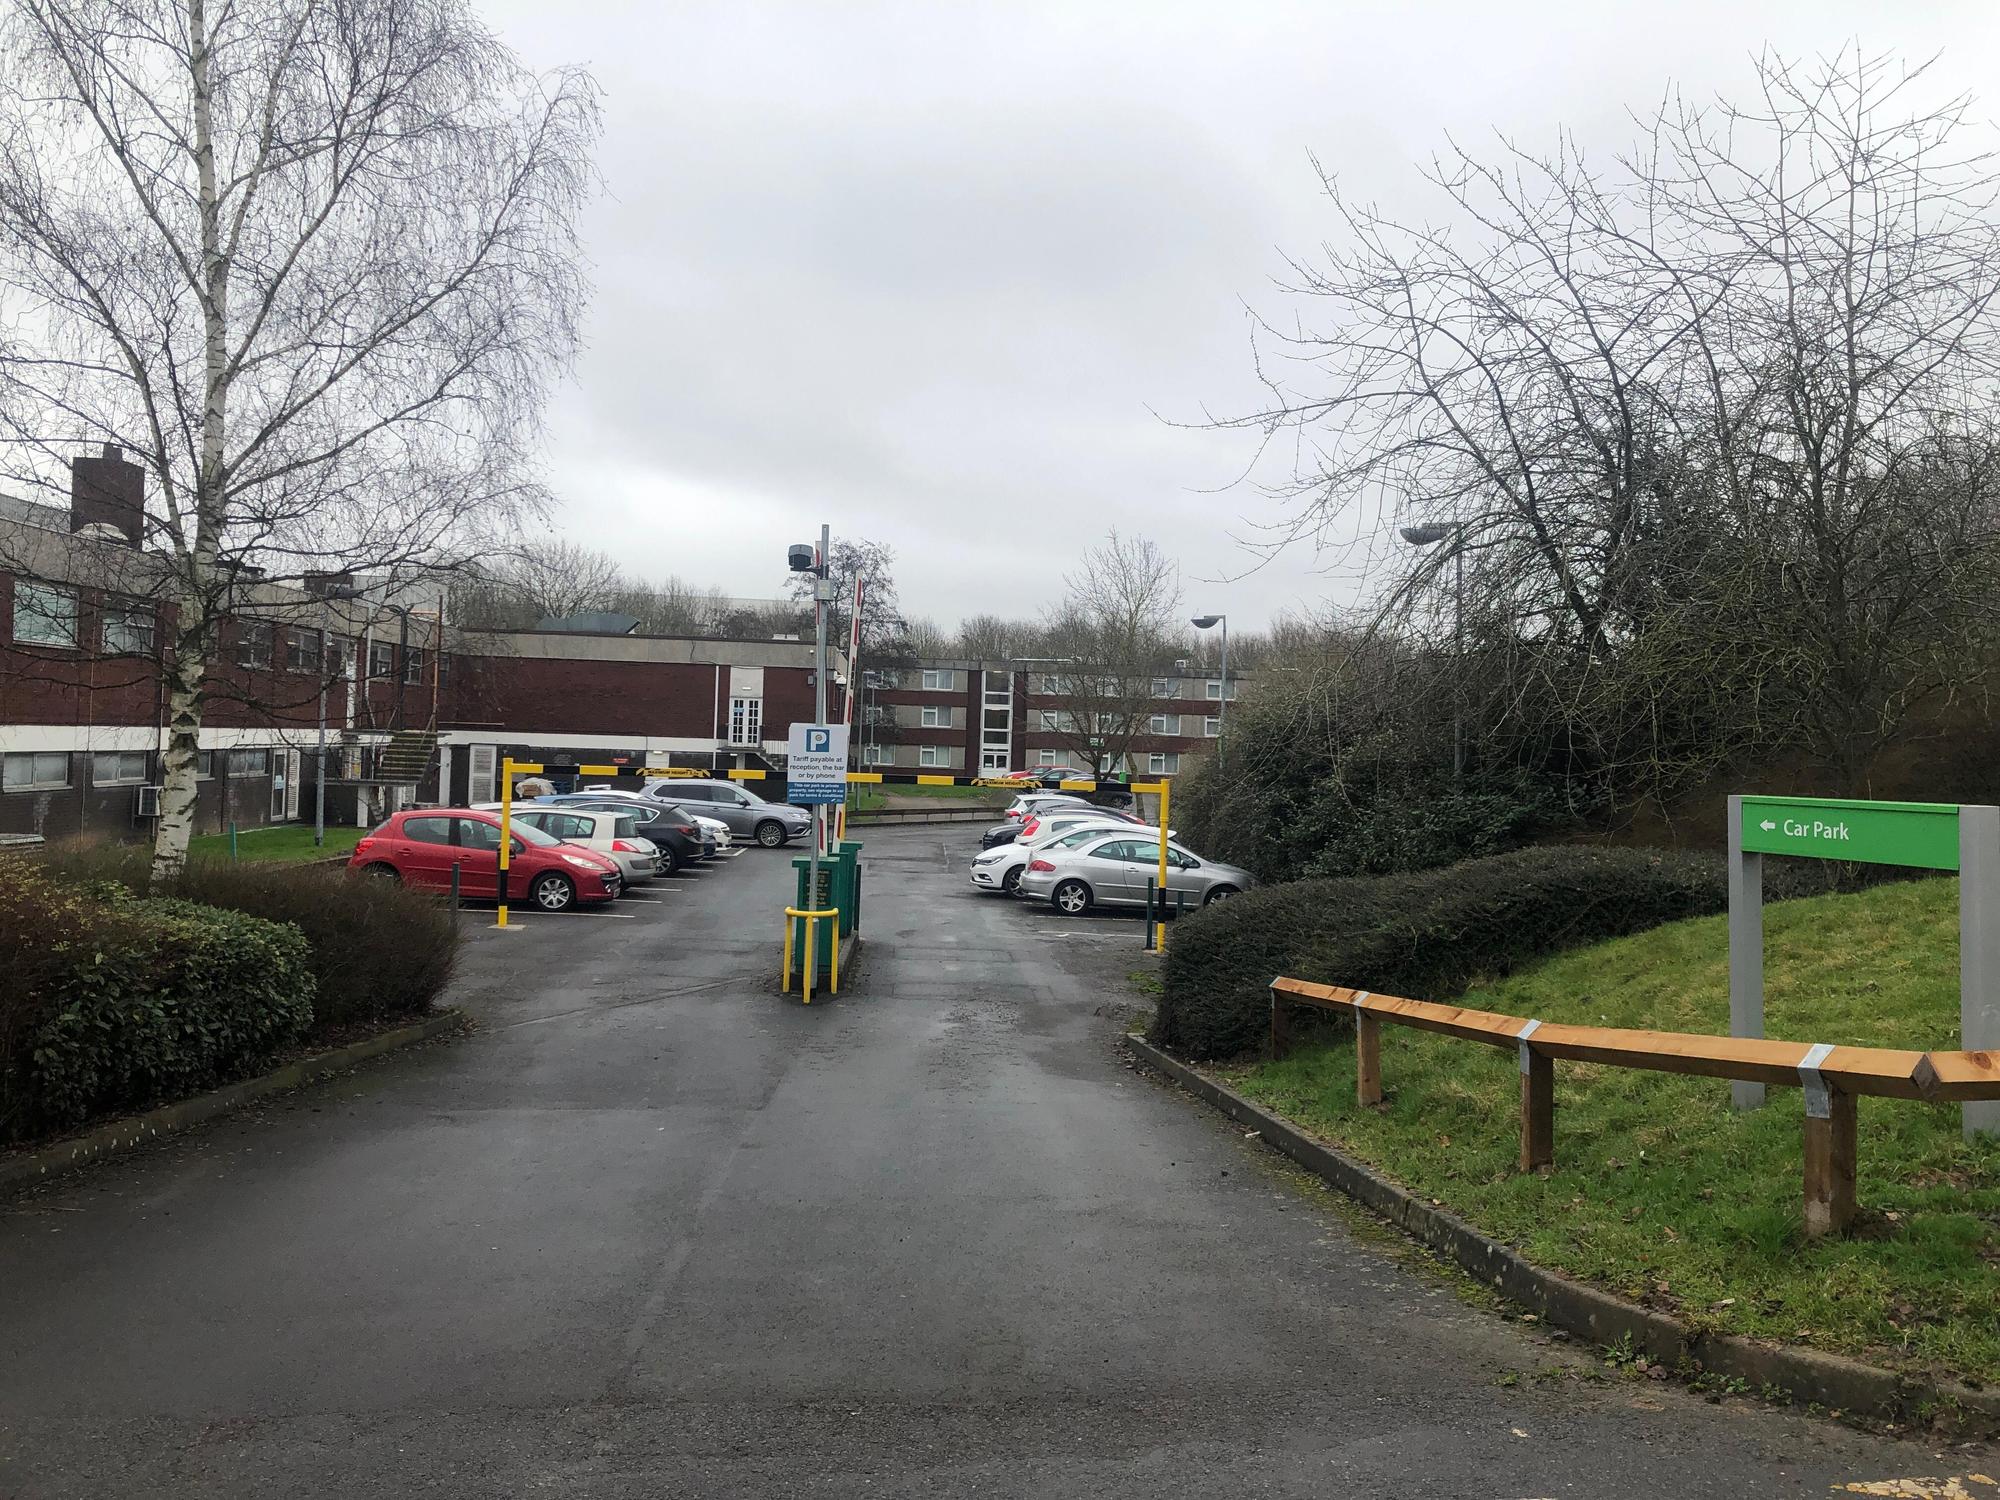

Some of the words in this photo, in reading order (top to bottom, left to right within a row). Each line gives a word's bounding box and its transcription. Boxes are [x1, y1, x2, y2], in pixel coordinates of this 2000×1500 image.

[810, 731, 827, 751] P
[1784, 819, 1810, 837] Car
[1814, 821, 1850, 840] Park
